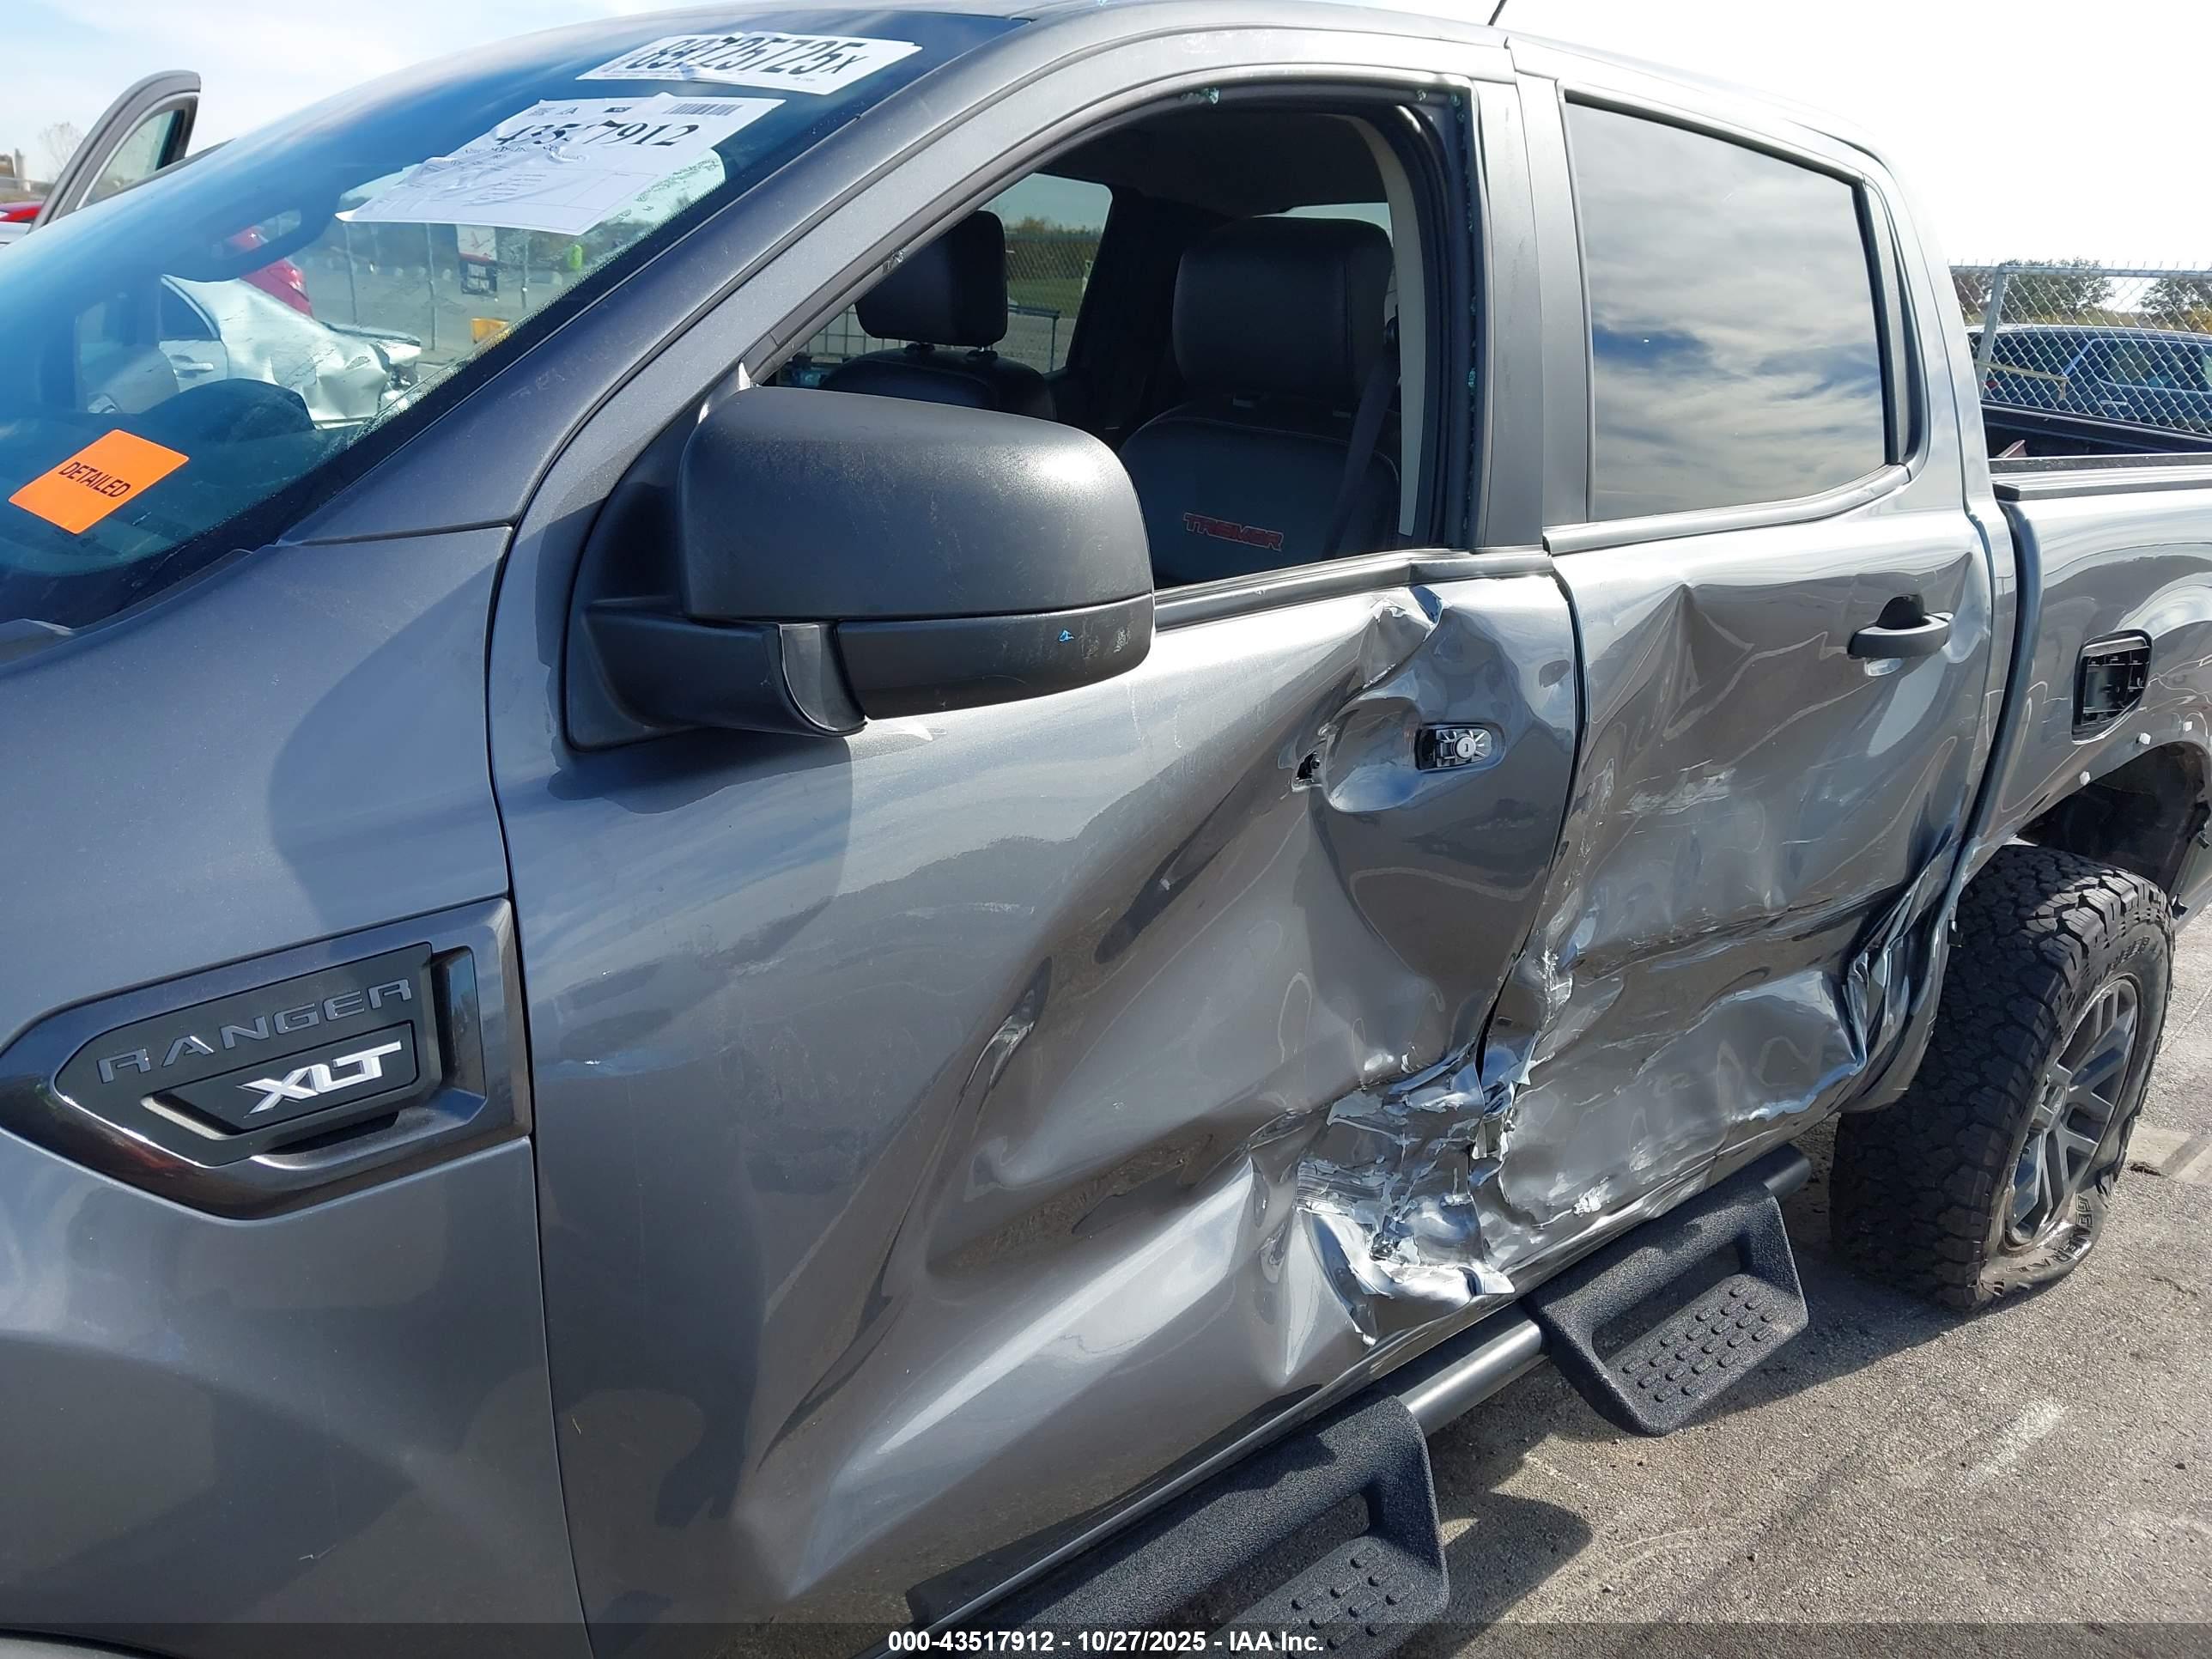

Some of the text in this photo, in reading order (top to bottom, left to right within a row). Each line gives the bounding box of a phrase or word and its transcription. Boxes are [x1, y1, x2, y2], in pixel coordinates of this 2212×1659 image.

[58, 461, 131, 498] DETAILED
[1183, 512, 1285, 551] TREMOR
[96, 978, 413, 1084] RANGER
[236, 1040, 403, 1117] XLT
